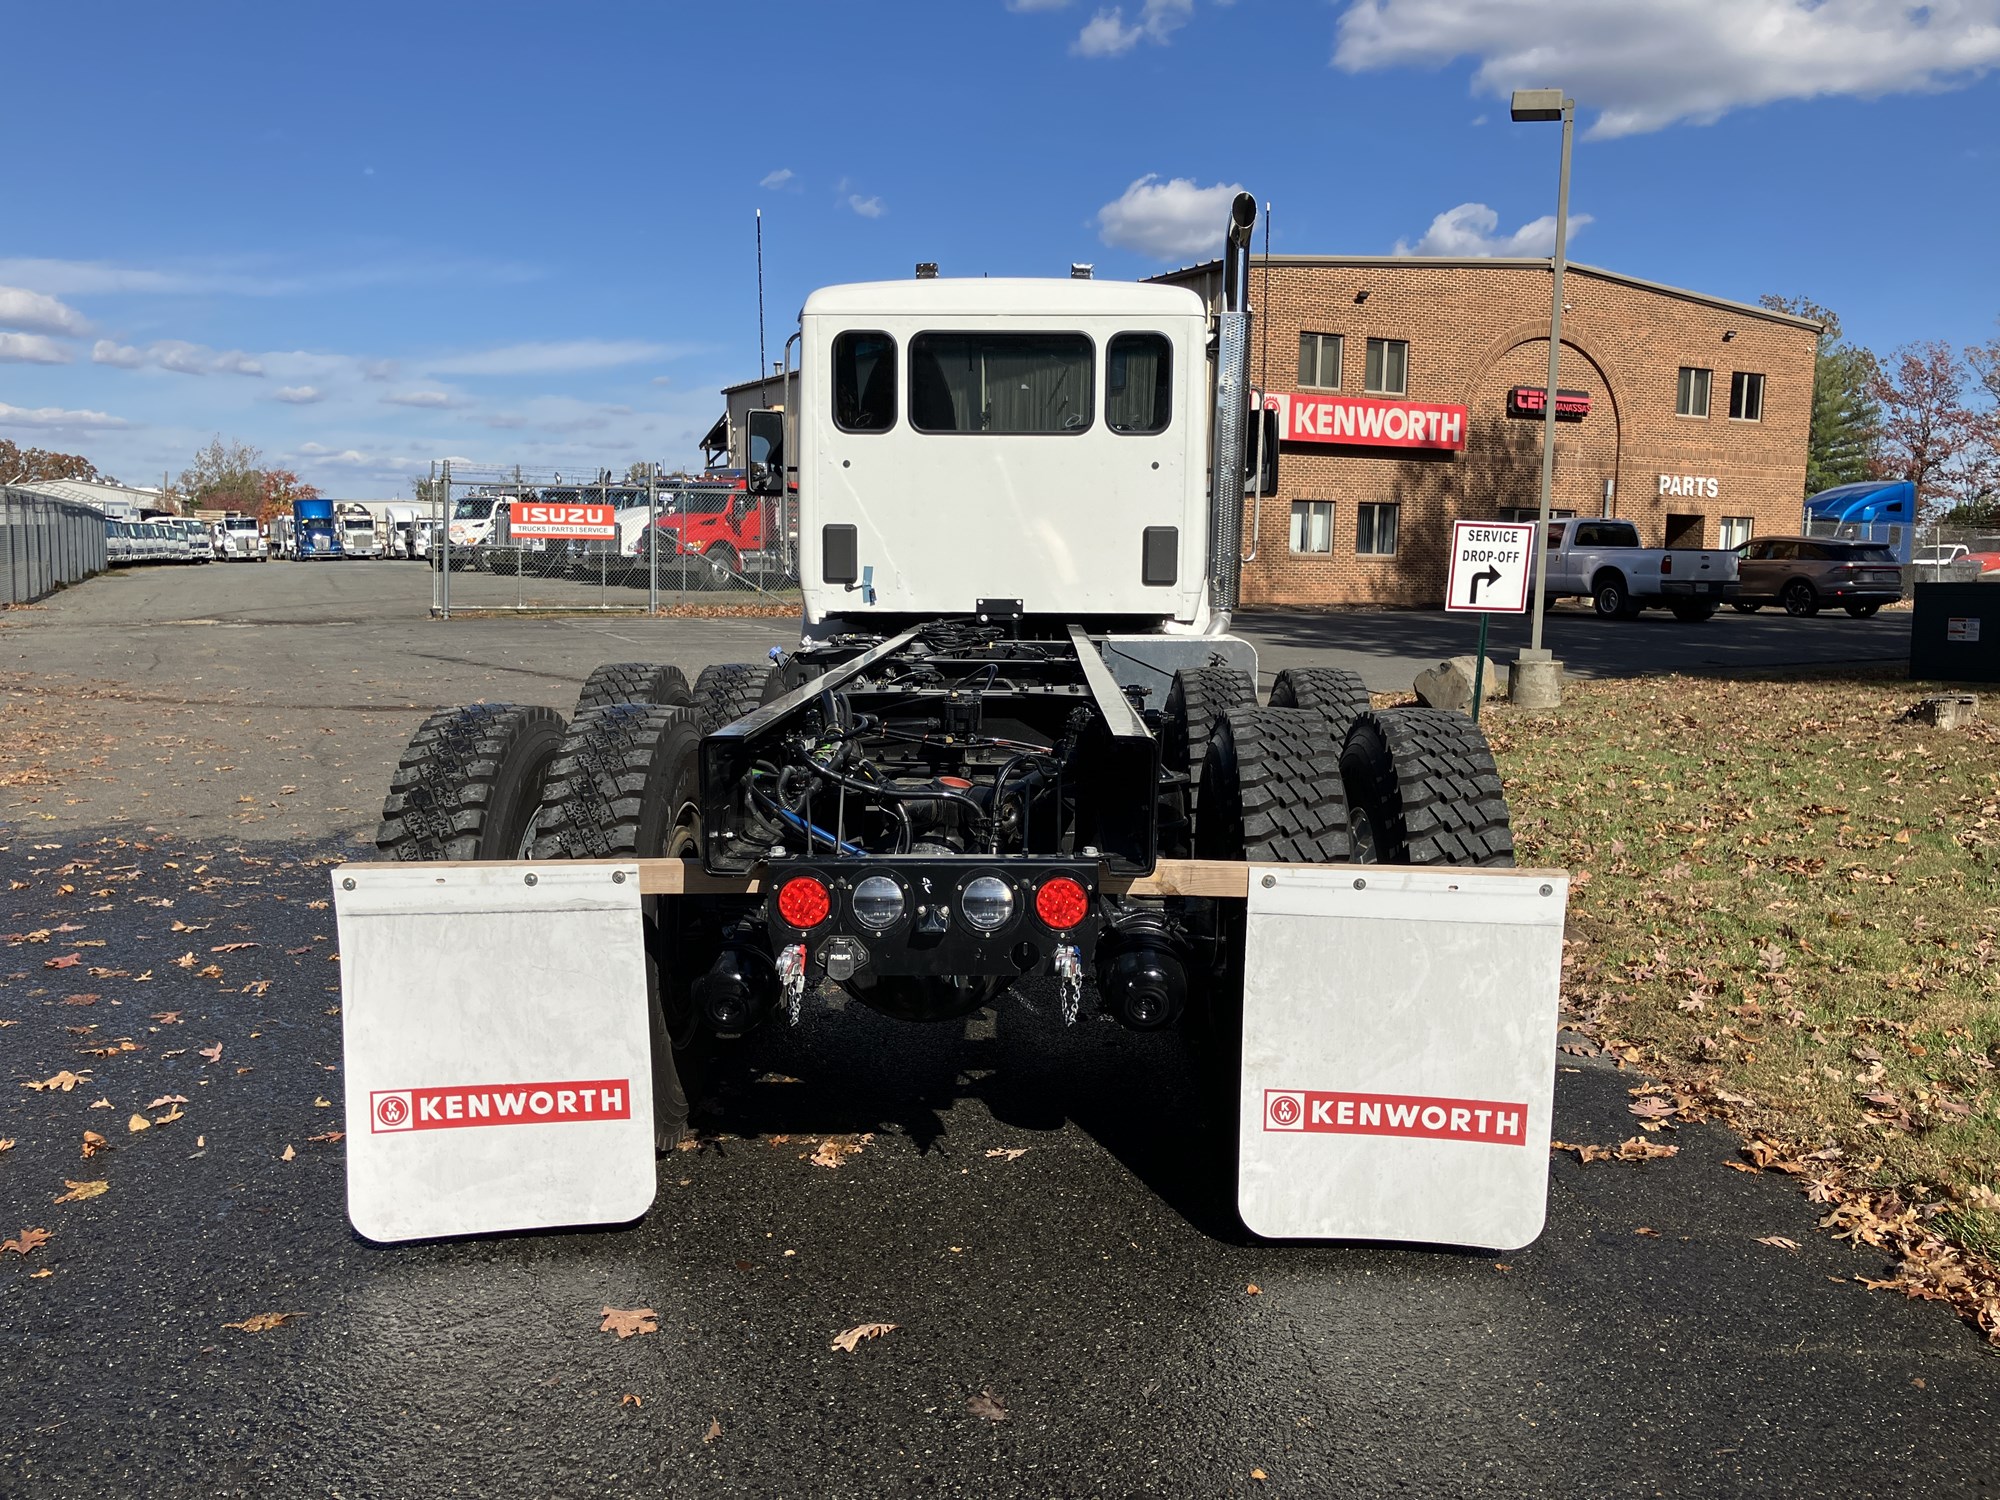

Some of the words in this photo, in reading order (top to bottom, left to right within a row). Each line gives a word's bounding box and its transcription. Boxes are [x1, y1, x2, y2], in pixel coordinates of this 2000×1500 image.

[1295, 402, 1461, 443] KENWORTH
[1659, 475, 1719, 498] PARTS
[522, 507, 603, 523] ISUZU
[1468, 529, 1518, 543] SERVICE
[1462, 550, 1520, 563] DROP-OFF
[419, 1088, 623, 1121] KENWORTH
[1311, 1100, 1519, 1136] KENWORTH
